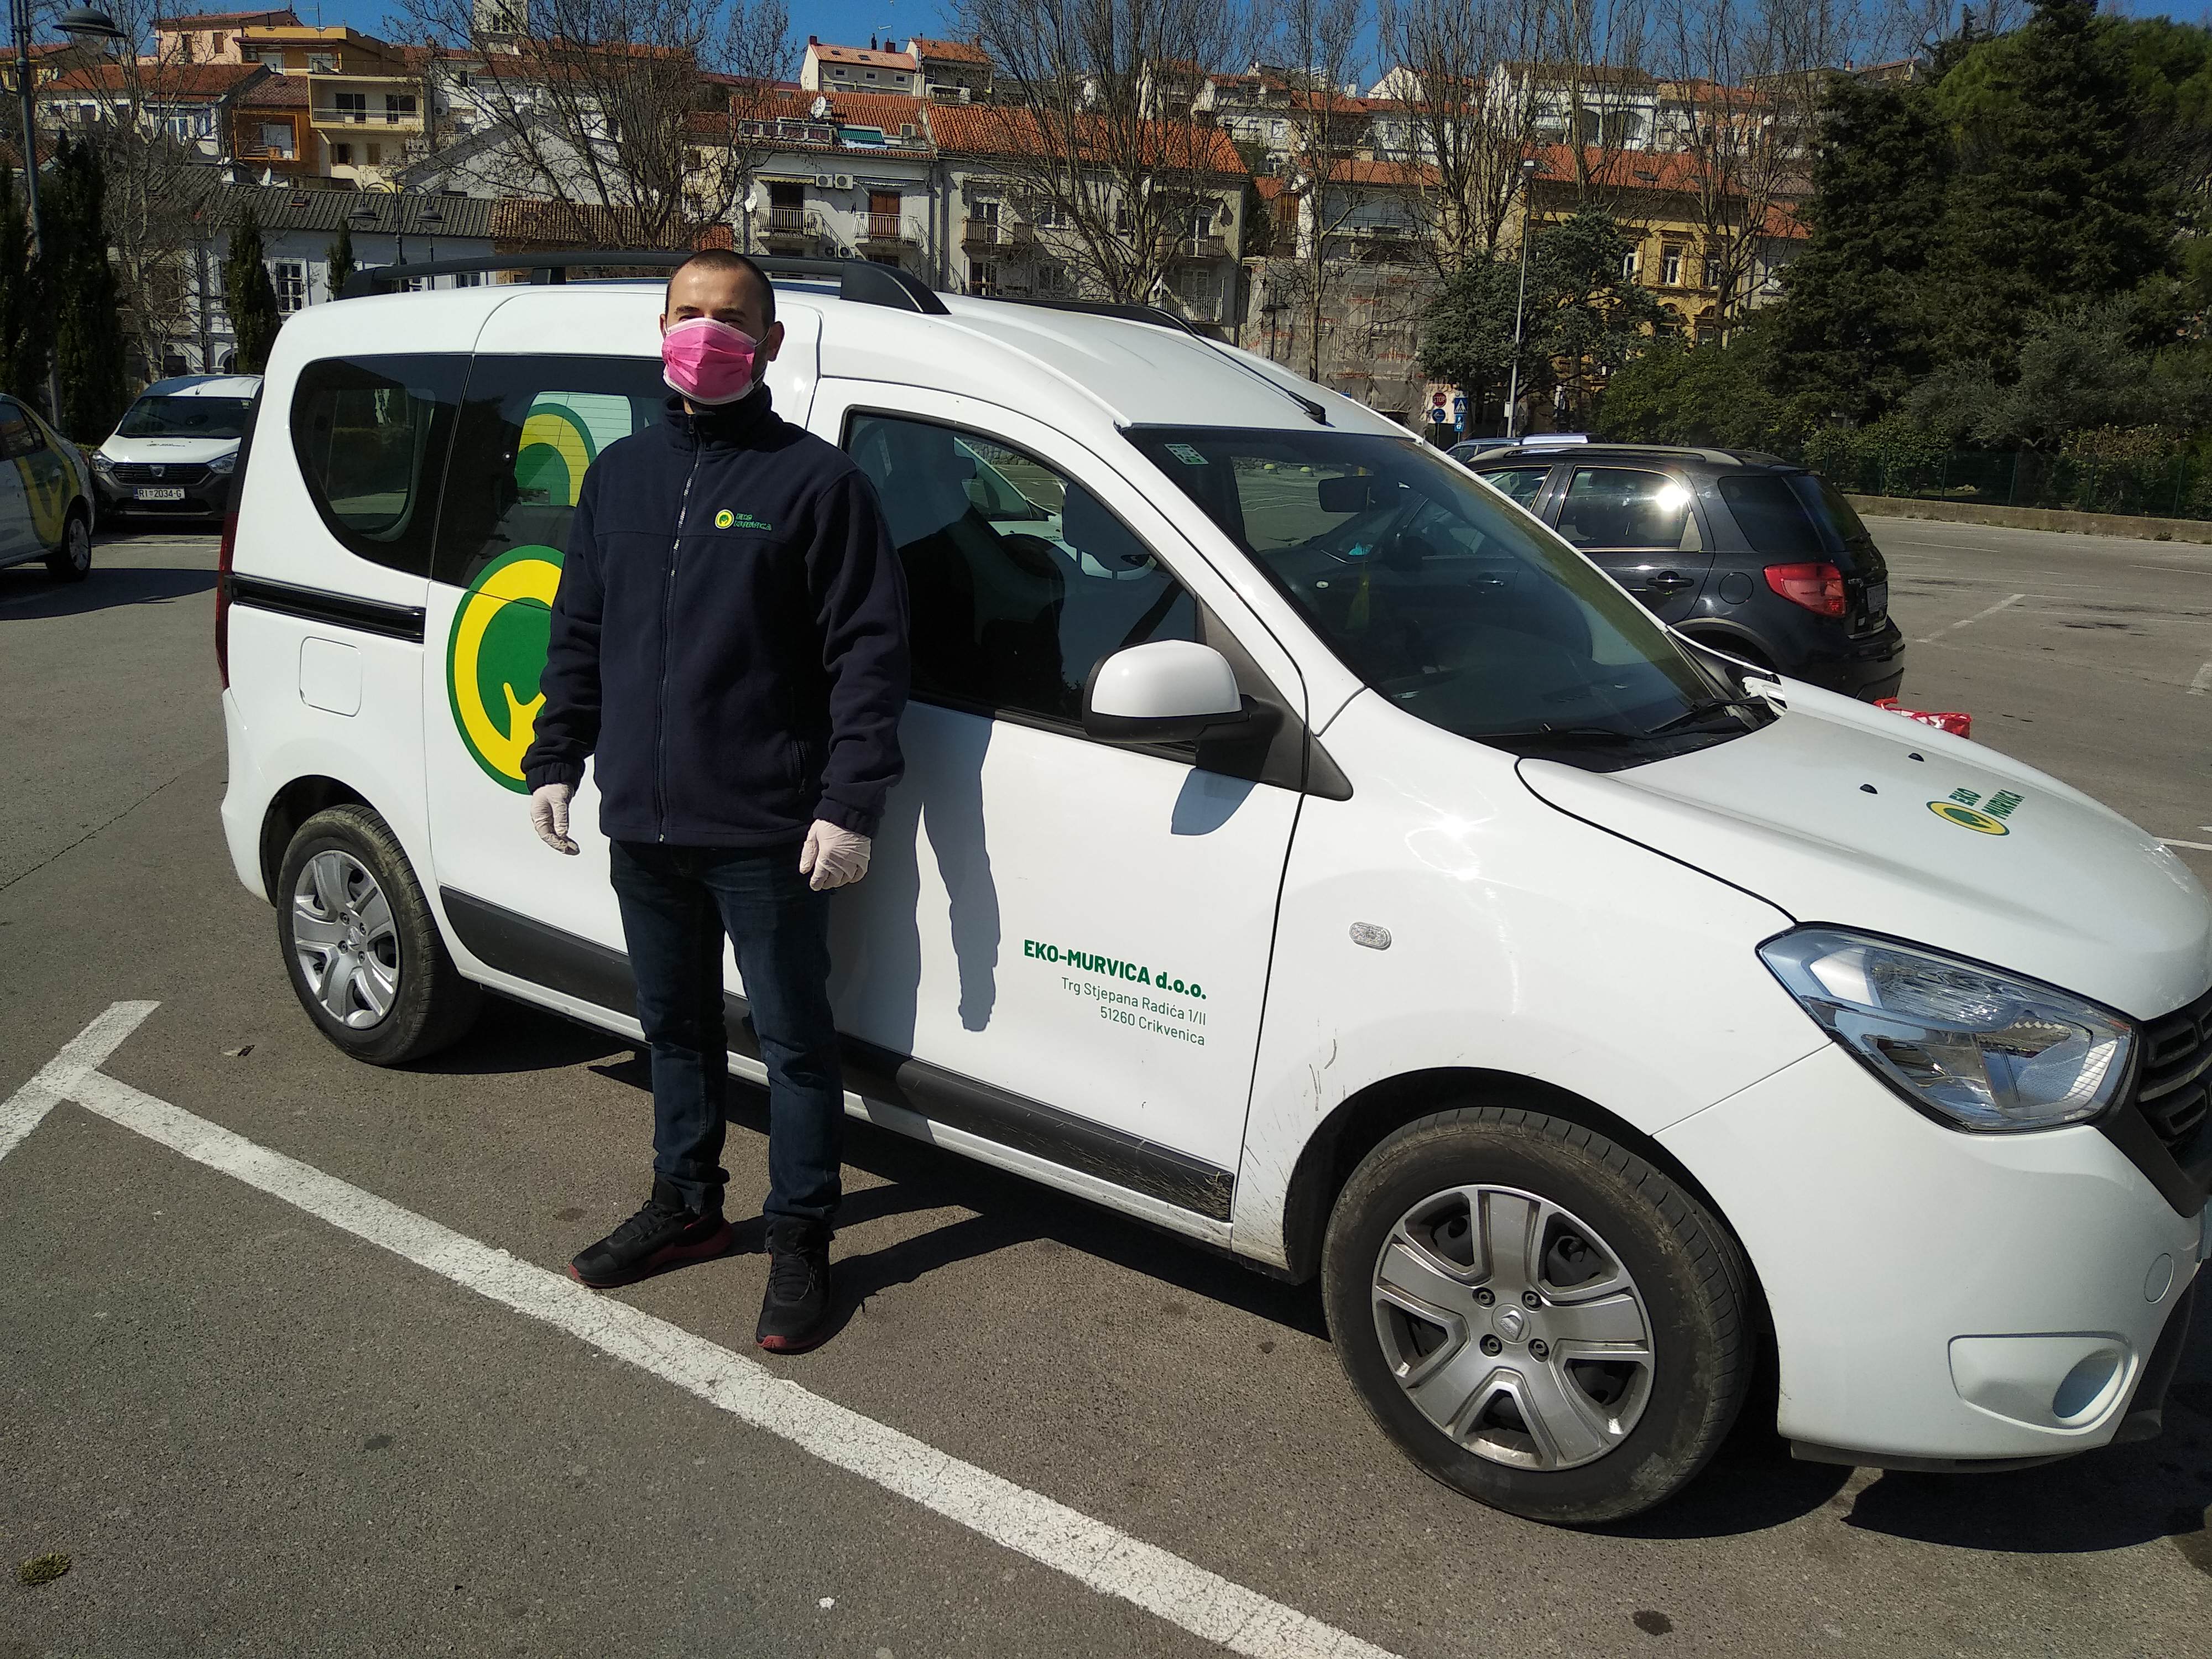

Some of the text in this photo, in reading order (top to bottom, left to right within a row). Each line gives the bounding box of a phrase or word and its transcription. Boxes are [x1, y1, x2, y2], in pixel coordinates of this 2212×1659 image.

[1948, 787, 1981, 807] EKO
[1981, 789, 2025, 820] MURVICA
[1024, 939, 1207, 1000] EKO-MURVICA d.o.o.
[1061, 977, 1206, 1026] Trg Stjepana Radića 1/II
[1100, 1005, 1204, 1046] 51260 Crikvenica
